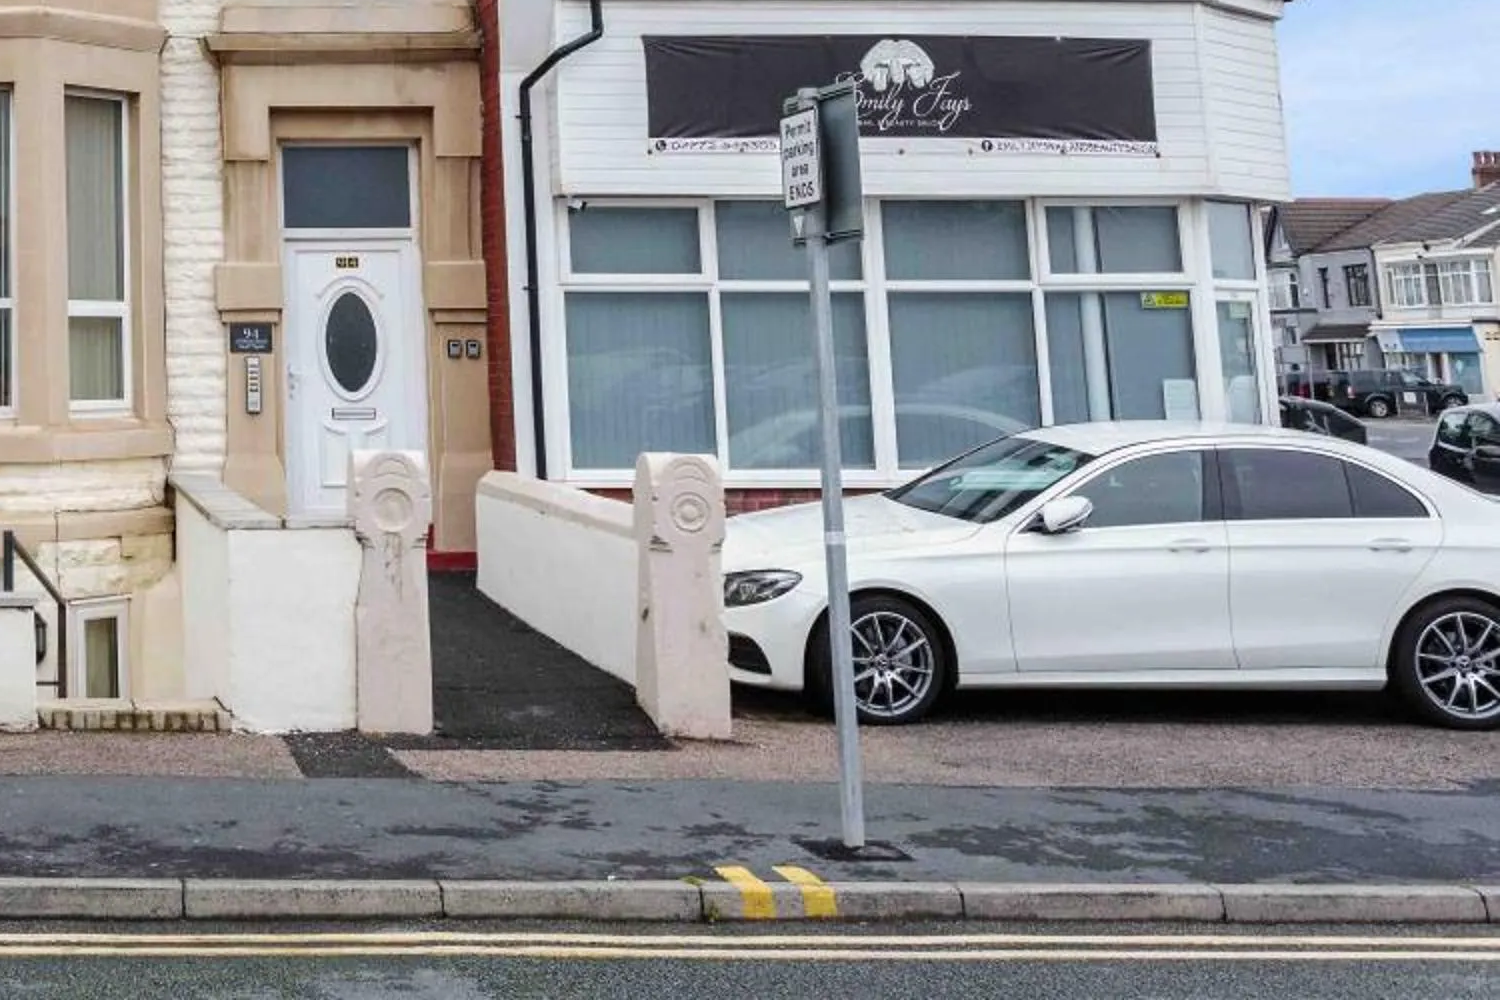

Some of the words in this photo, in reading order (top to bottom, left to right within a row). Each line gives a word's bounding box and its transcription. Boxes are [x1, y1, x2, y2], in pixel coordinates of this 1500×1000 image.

[785, 120, 811, 138] Permit
[784, 141, 815, 160] parking
[789, 181, 815, 201] ENDS
